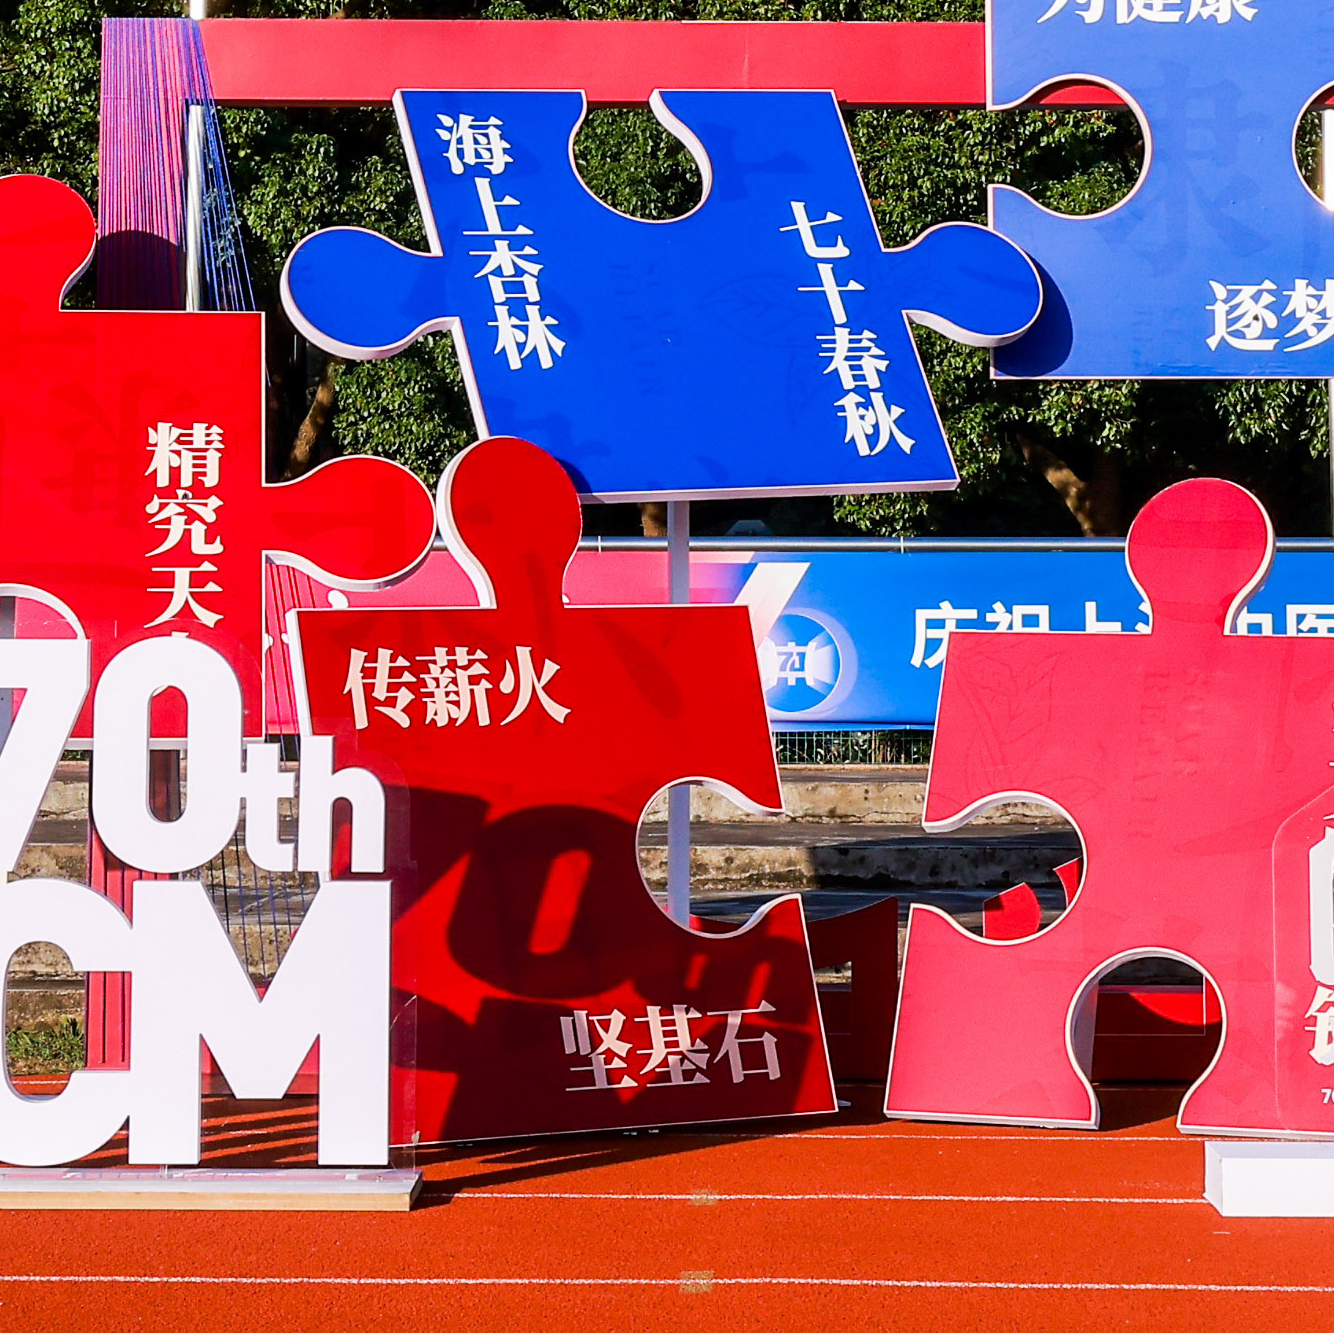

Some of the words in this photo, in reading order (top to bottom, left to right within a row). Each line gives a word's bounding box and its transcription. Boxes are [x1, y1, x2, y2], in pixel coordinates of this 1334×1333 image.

[435, 113, 567, 371] 海上杏林
[779, 200, 916, 457] 七十春秋
[144, 422, 225, 639] 精究天
[342, 645, 572, 730] 传薪火
[560, 999, 783, 1092] 坚基石
